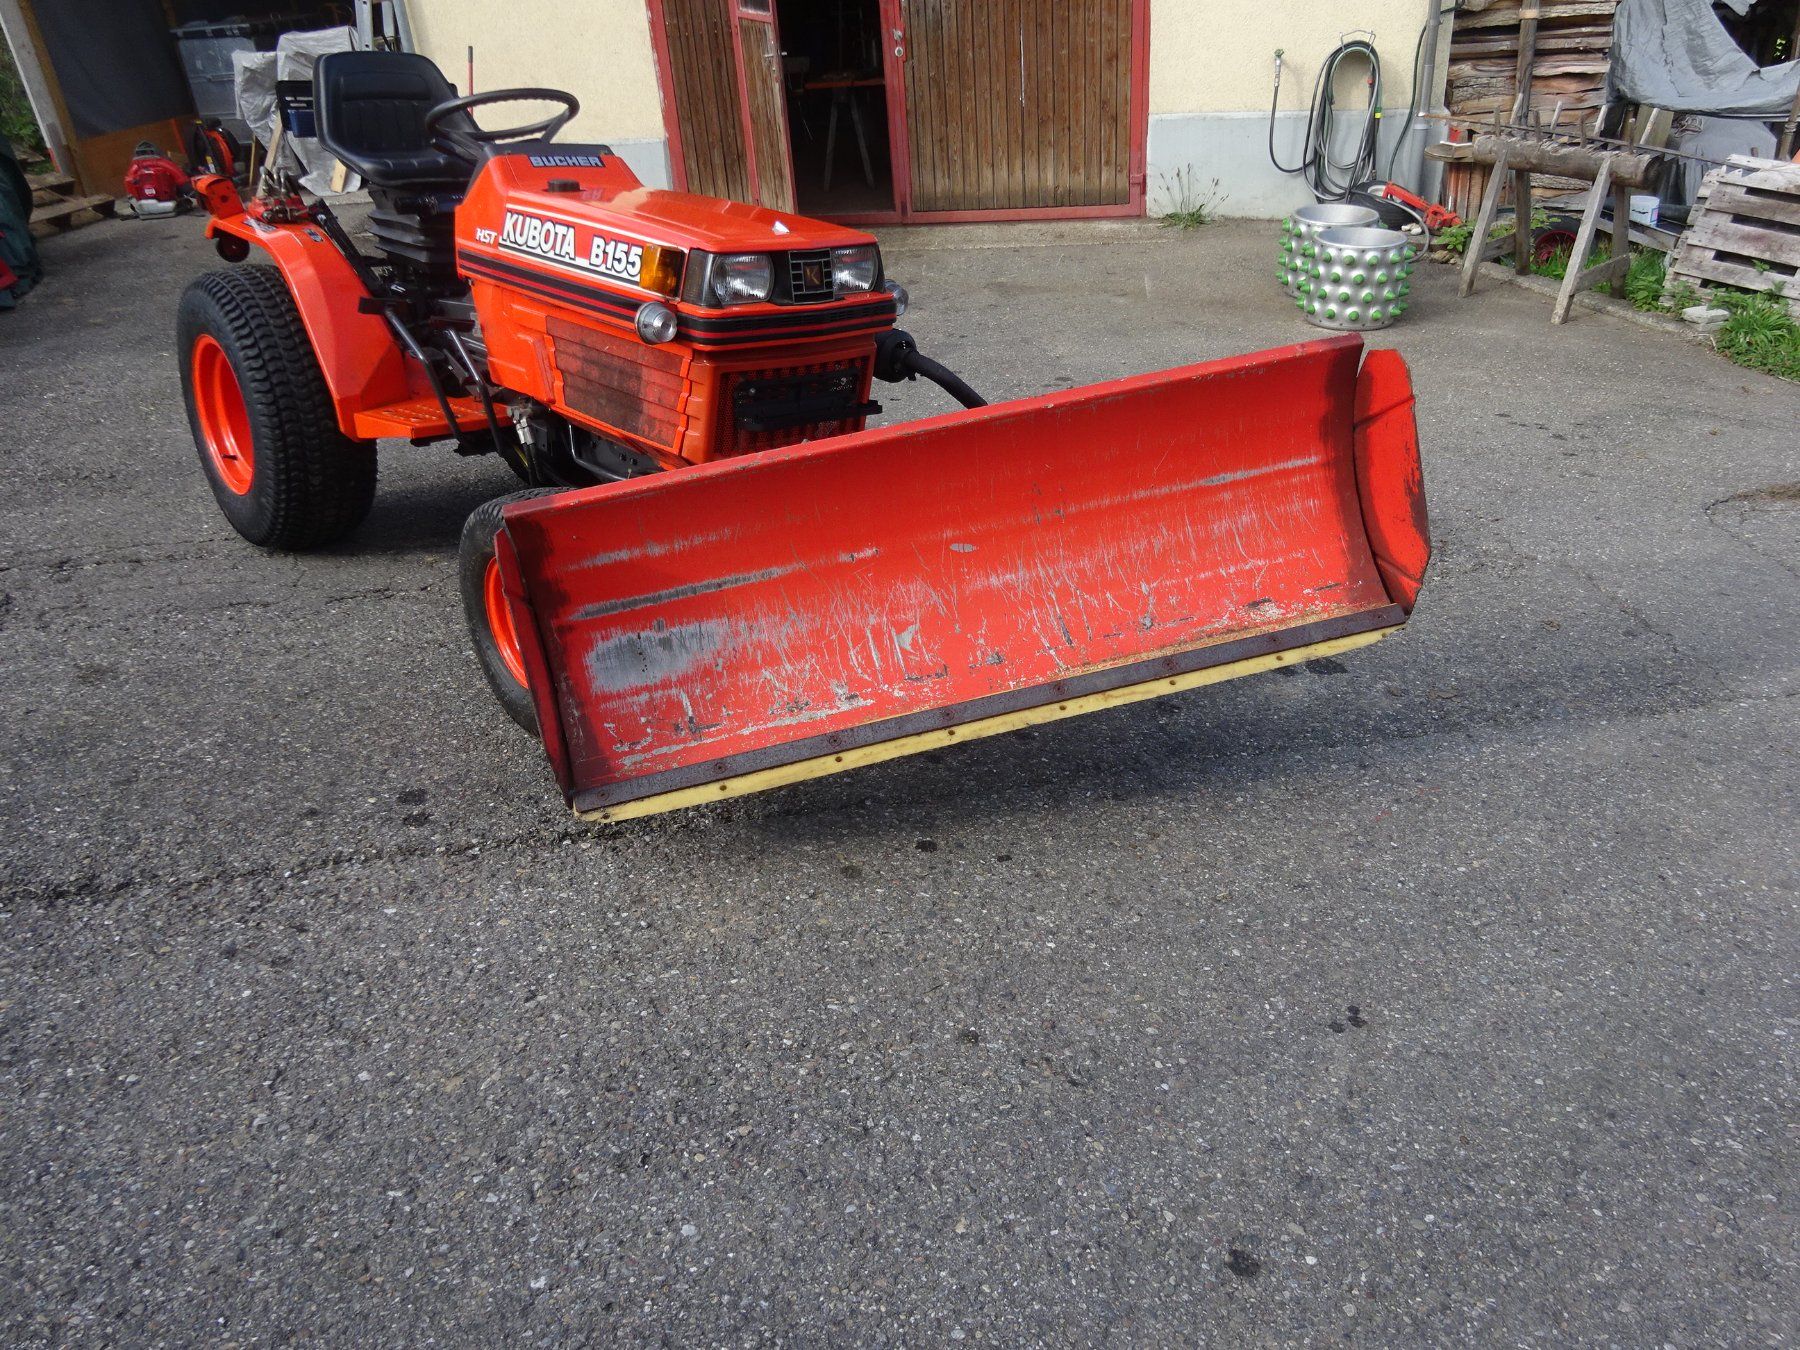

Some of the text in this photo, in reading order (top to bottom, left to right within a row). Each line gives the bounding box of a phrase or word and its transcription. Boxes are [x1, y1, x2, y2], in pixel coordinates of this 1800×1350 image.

[529, 155, 605, 168] BUCHER
[475, 228, 498, 245] HST
[501, 210, 643, 277] KUBOTA B155
